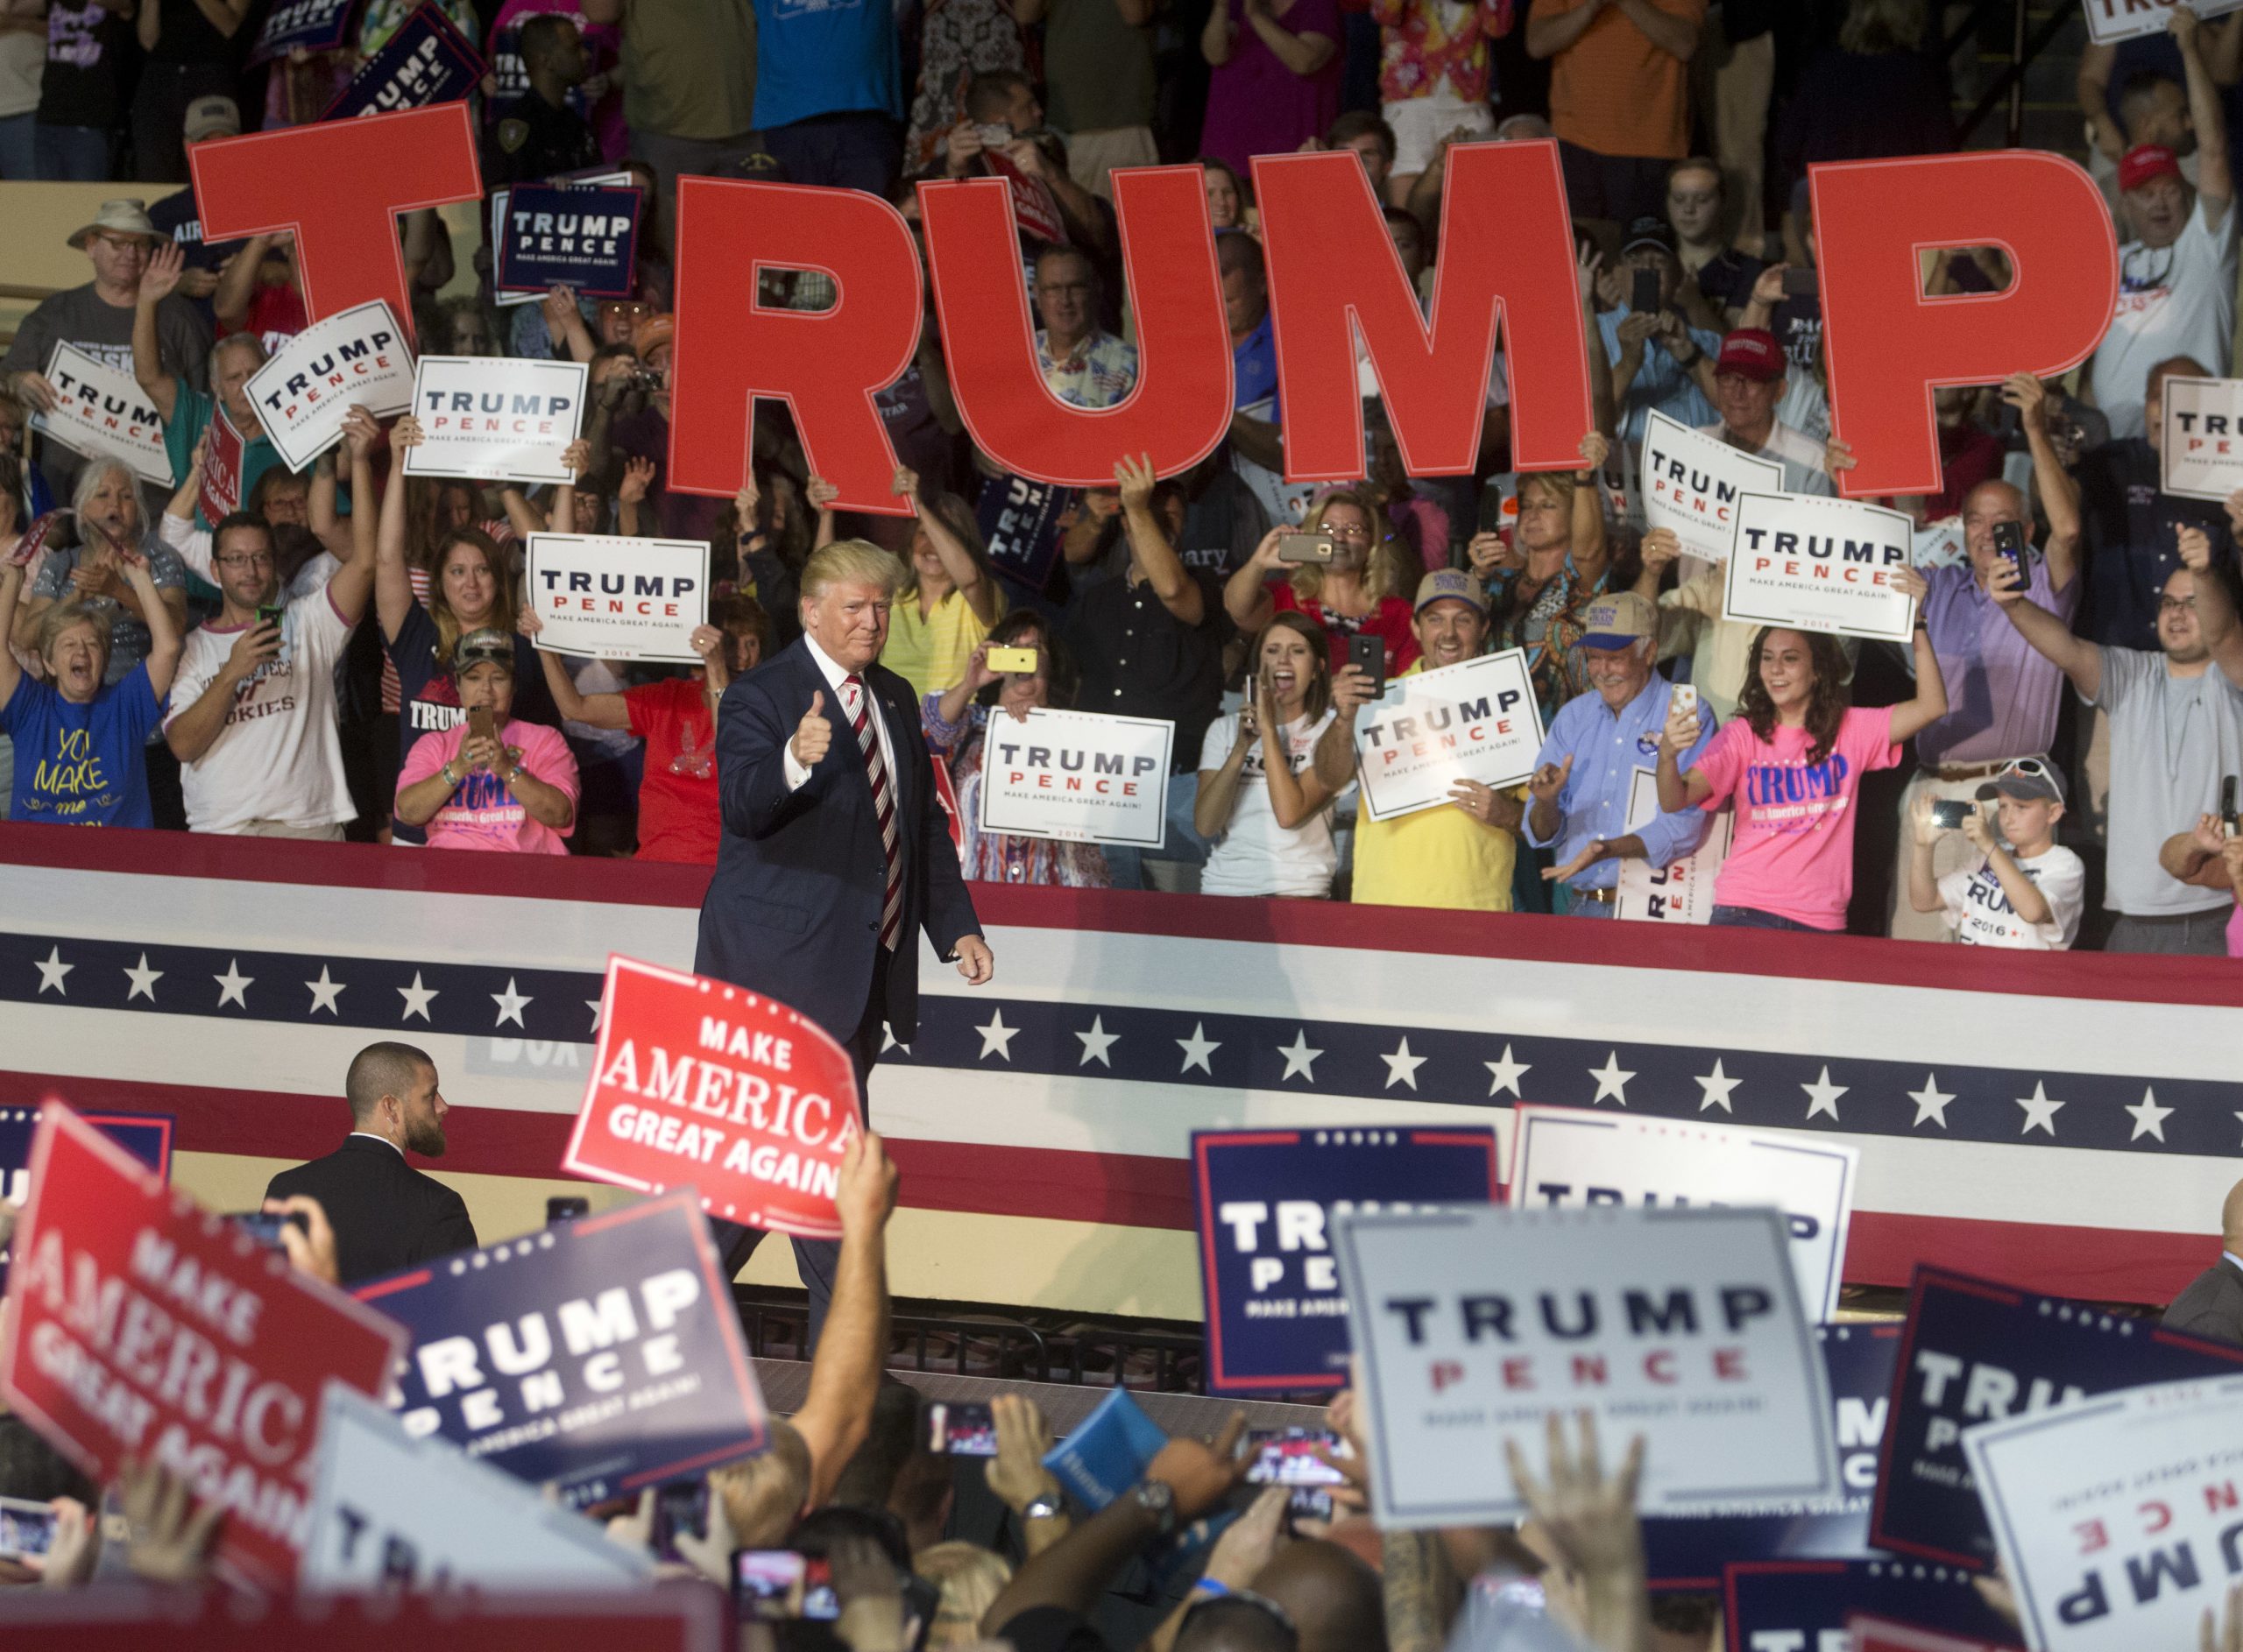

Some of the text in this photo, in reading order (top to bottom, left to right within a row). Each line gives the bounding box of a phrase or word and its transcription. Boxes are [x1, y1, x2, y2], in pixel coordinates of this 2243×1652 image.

[357, 34, 439, 118] RUMP
[513, 211, 631, 238] TRUMP
[520, 236, 617, 255] PENCE
[264, 331, 393, 411] TRUMP
[284, 355, 391, 420] PENCE
[58, 371, 159, 427] TRUM
[60, 395, 164, 445] PENCE
[289, 413, 310, 432] MAKE
[311, 388, 345, 415] AMERICA
[345, 378, 371, 392] GREAT
[426, 392, 570, 416] TRUMP
[434, 416, 553, 434] PENCE
[454, 435, 492, 444] AMERICA
[1652, 448, 1737, 504] TRUM
[987, 477, 1030, 555] TRU
[1011, 488, 1043, 554] PEN
[1655, 478, 1731, 522] PENC
[1667, 505, 1699, 524] AMERICA
[1701, 518, 1727, 532] GREAT
[1744, 527, 1905, 566] TRUMP
[541, 569, 695, 598] TRUMP
[1749, 577, 1891, 600] MAKE AMERICA GREAT AGAIN!
[1754, 557, 1888, 586] PENCE
[549, 613, 683, 630] MAKE AMERICA GREAT AGAIN!
[554, 596, 679, 617] PENCE
[604, 649, 631, 658] 2016
[224, 695, 295, 726] OKIES
[409, 700, 467, 731] TRUM
[1362, 688, 1521, 748] TRUMP
[999, 744, 1157, 777] TRUMP
[1383, 718, 1513, 766] PENCE
[1383, 766, 1409, 779] MAKE
[1456, 746, 1486, 759] GREAT
[1489, 738, 1521, 751] AGAIN!
[33, 759, 109, 795] MAKE
[1009, 772, 1138, 796] PENCE
[1747, 753, 1849, 806] TRUMP
[1004, 791, 1141, 810] MAKE AMERICA GREAT AGAIN!
[1971, 917, 2006, 936] 2016
[699, 1015, 793, 1071] MAKE
[608, 1103, 725, 1163] GREAT
[130, 1226, 266, 1347] MAKE
[386, 1267, 701, 1408] RUMP
[1383, 1284, 1775, 1348] TRUMP
[22, 1226, 315, 1480] AMERIC
[1426, 1345, 1752, 1394] PENCE
[401, 1333, 684, 1438] PENCE
[2070, 1478, 2239, 1557] NCE
